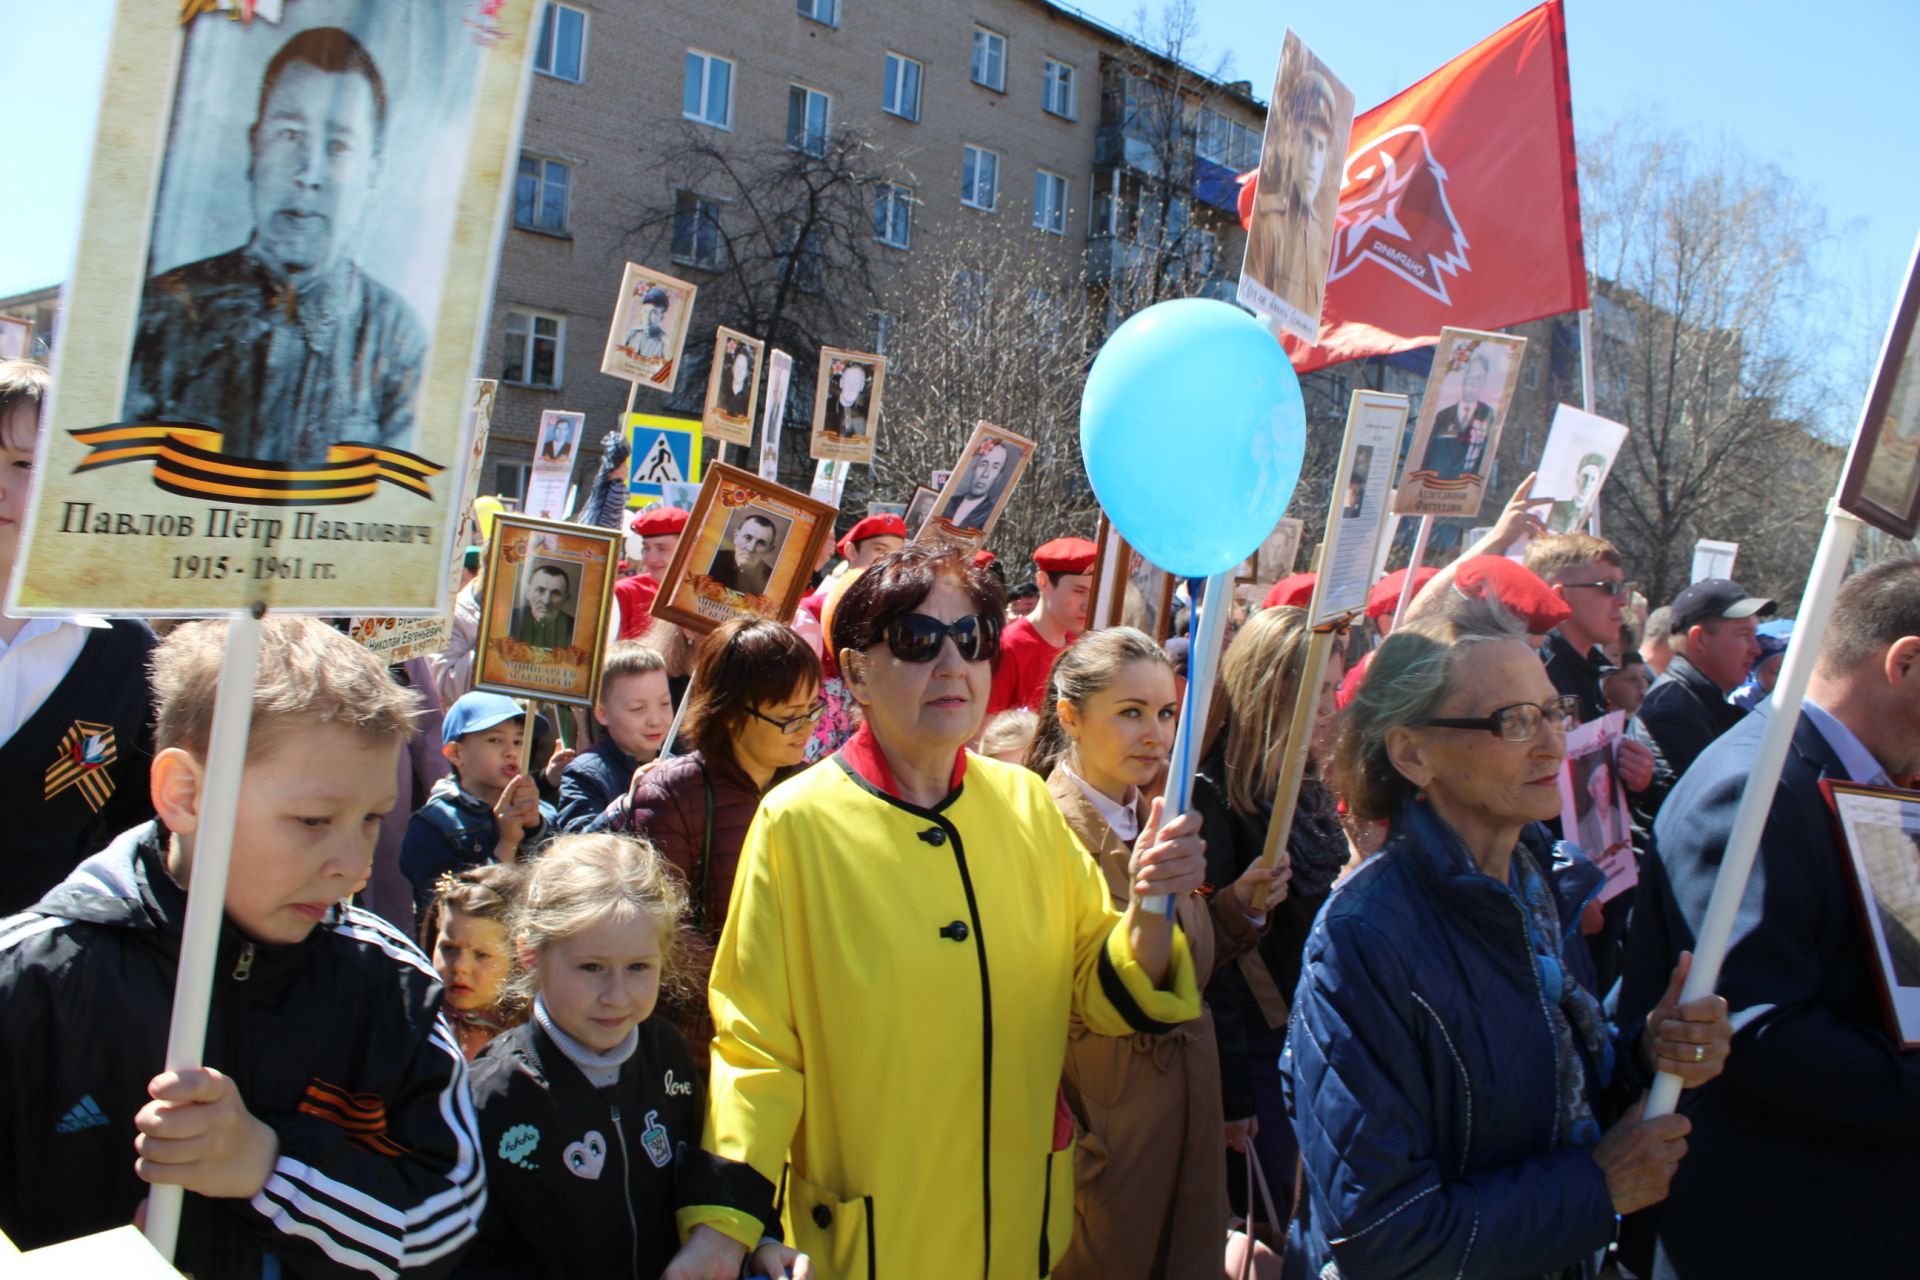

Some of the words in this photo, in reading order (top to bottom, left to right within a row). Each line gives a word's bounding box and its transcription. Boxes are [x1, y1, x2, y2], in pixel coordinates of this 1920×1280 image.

[58, 501, 195, 537] Павлов
[204, 508, 283, 548] Пётр
[290, 511, 433, 544] Павлович
[172, 555, 230, 579] 1915
[252, 556, 303, 580] 1961
[402, 626, 441, 644] Евгеньевич
[664, 1069, 692, 1096] love
